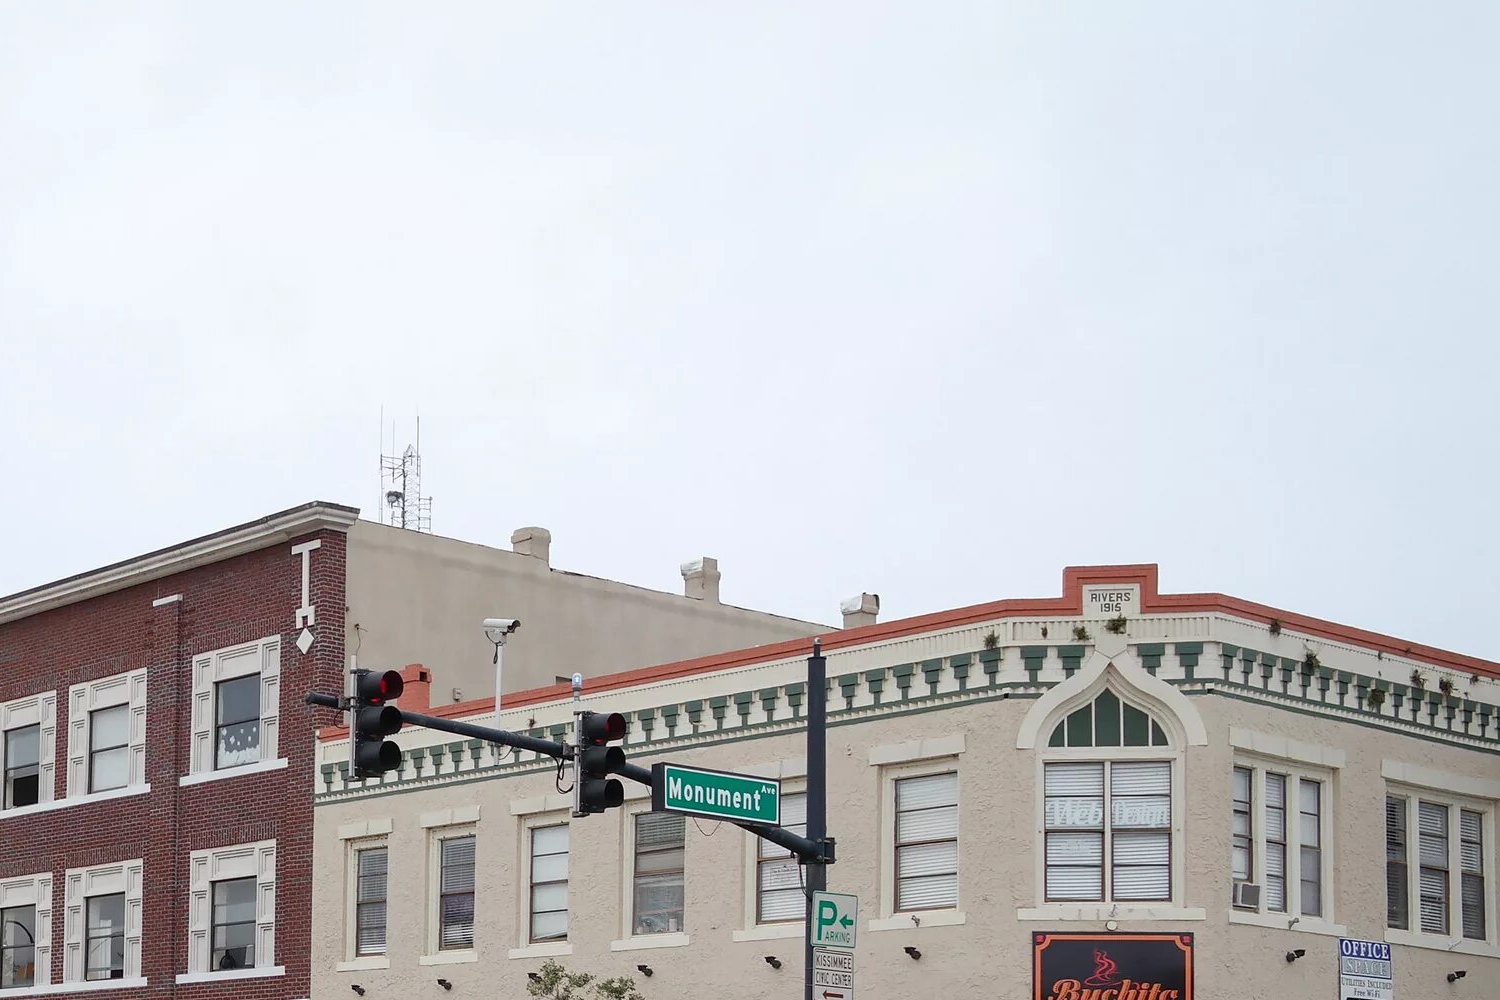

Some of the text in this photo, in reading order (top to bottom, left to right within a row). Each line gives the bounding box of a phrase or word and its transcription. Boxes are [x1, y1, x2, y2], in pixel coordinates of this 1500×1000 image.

[1091, 593, 1131, 602] RIVERS
[1100, 603, 1122, 612] 1915
[669, 776, 776, 811] Monument Ave
[1342, 940, 1389, 959] OFFICE
[816, 954, 852, 970] KISSIMMEE
[1346, 959, 1387, 976] SPACE
[816, 971, 852, 986] CIVIC CENTER
